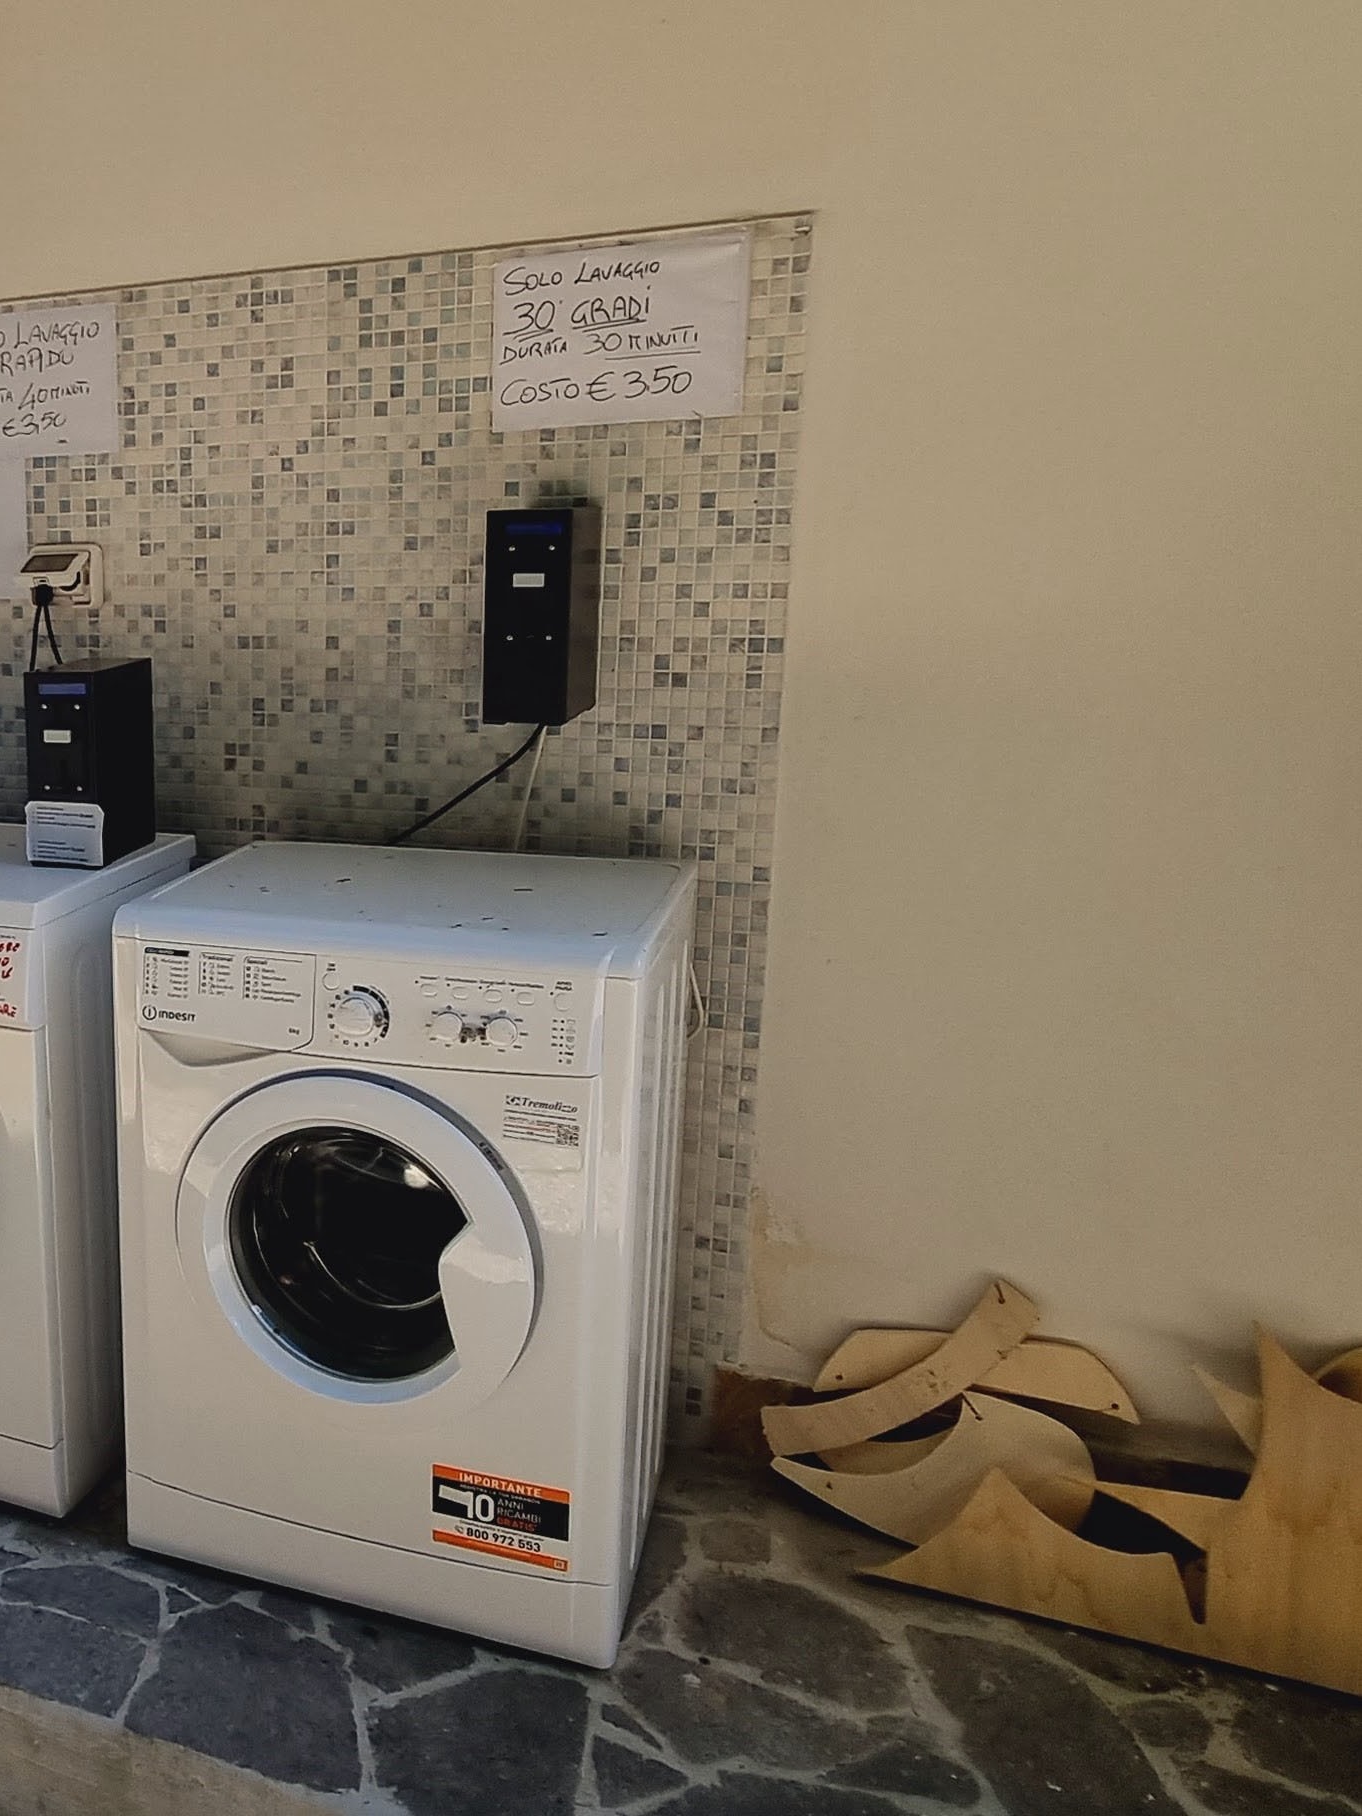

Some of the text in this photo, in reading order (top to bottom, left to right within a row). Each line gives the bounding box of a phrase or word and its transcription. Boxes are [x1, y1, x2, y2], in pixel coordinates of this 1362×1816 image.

[502, 261, 661, 297] SOLO LAVAGGIO
[570, 285, 651, 324] GRADI
[14, 321, 100, 349] LAVAGGIO
[499, 336, 568, 366] DURATA
[583, 332, 623, 355] 30
[500, 377, 580, 406] COSTO
[459, 1472, 543, 1498] IMPORTANTE
[497, 1498, 525, 1511] ANNI
[466, 1527, 490, 1541] 800
[492, 1531, 516, 1548] 972
